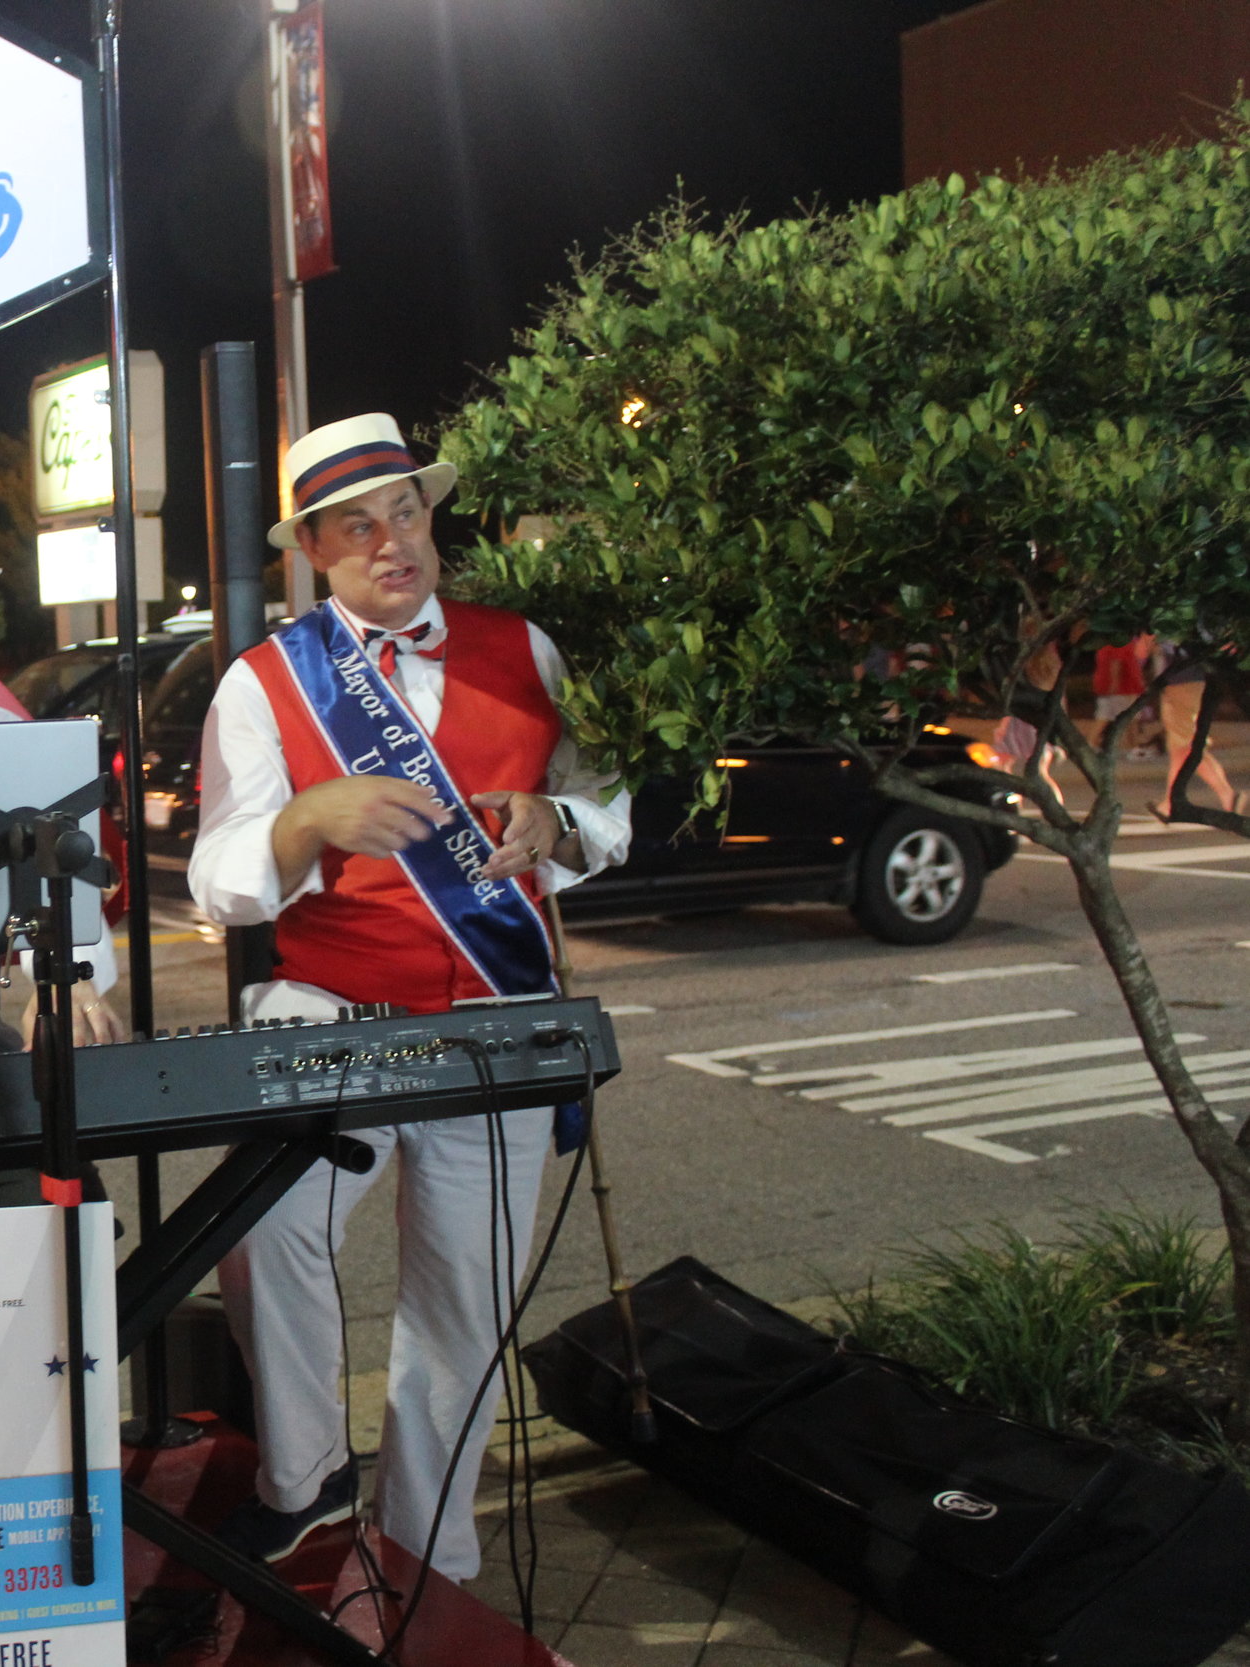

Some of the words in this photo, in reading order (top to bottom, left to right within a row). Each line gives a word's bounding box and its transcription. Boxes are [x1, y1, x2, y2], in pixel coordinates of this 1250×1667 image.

[333, 650, 390, 719] Mayor
[382, 723, 420, 752] of
[445, 828, 506, 906] Street
[8, 1529, 44, 1545] MOBILE
[46, 1527, 64, 1541] APP
[3, 1564, 64, 1593] 33733
[0, 1640, 53, 1667] FREE
